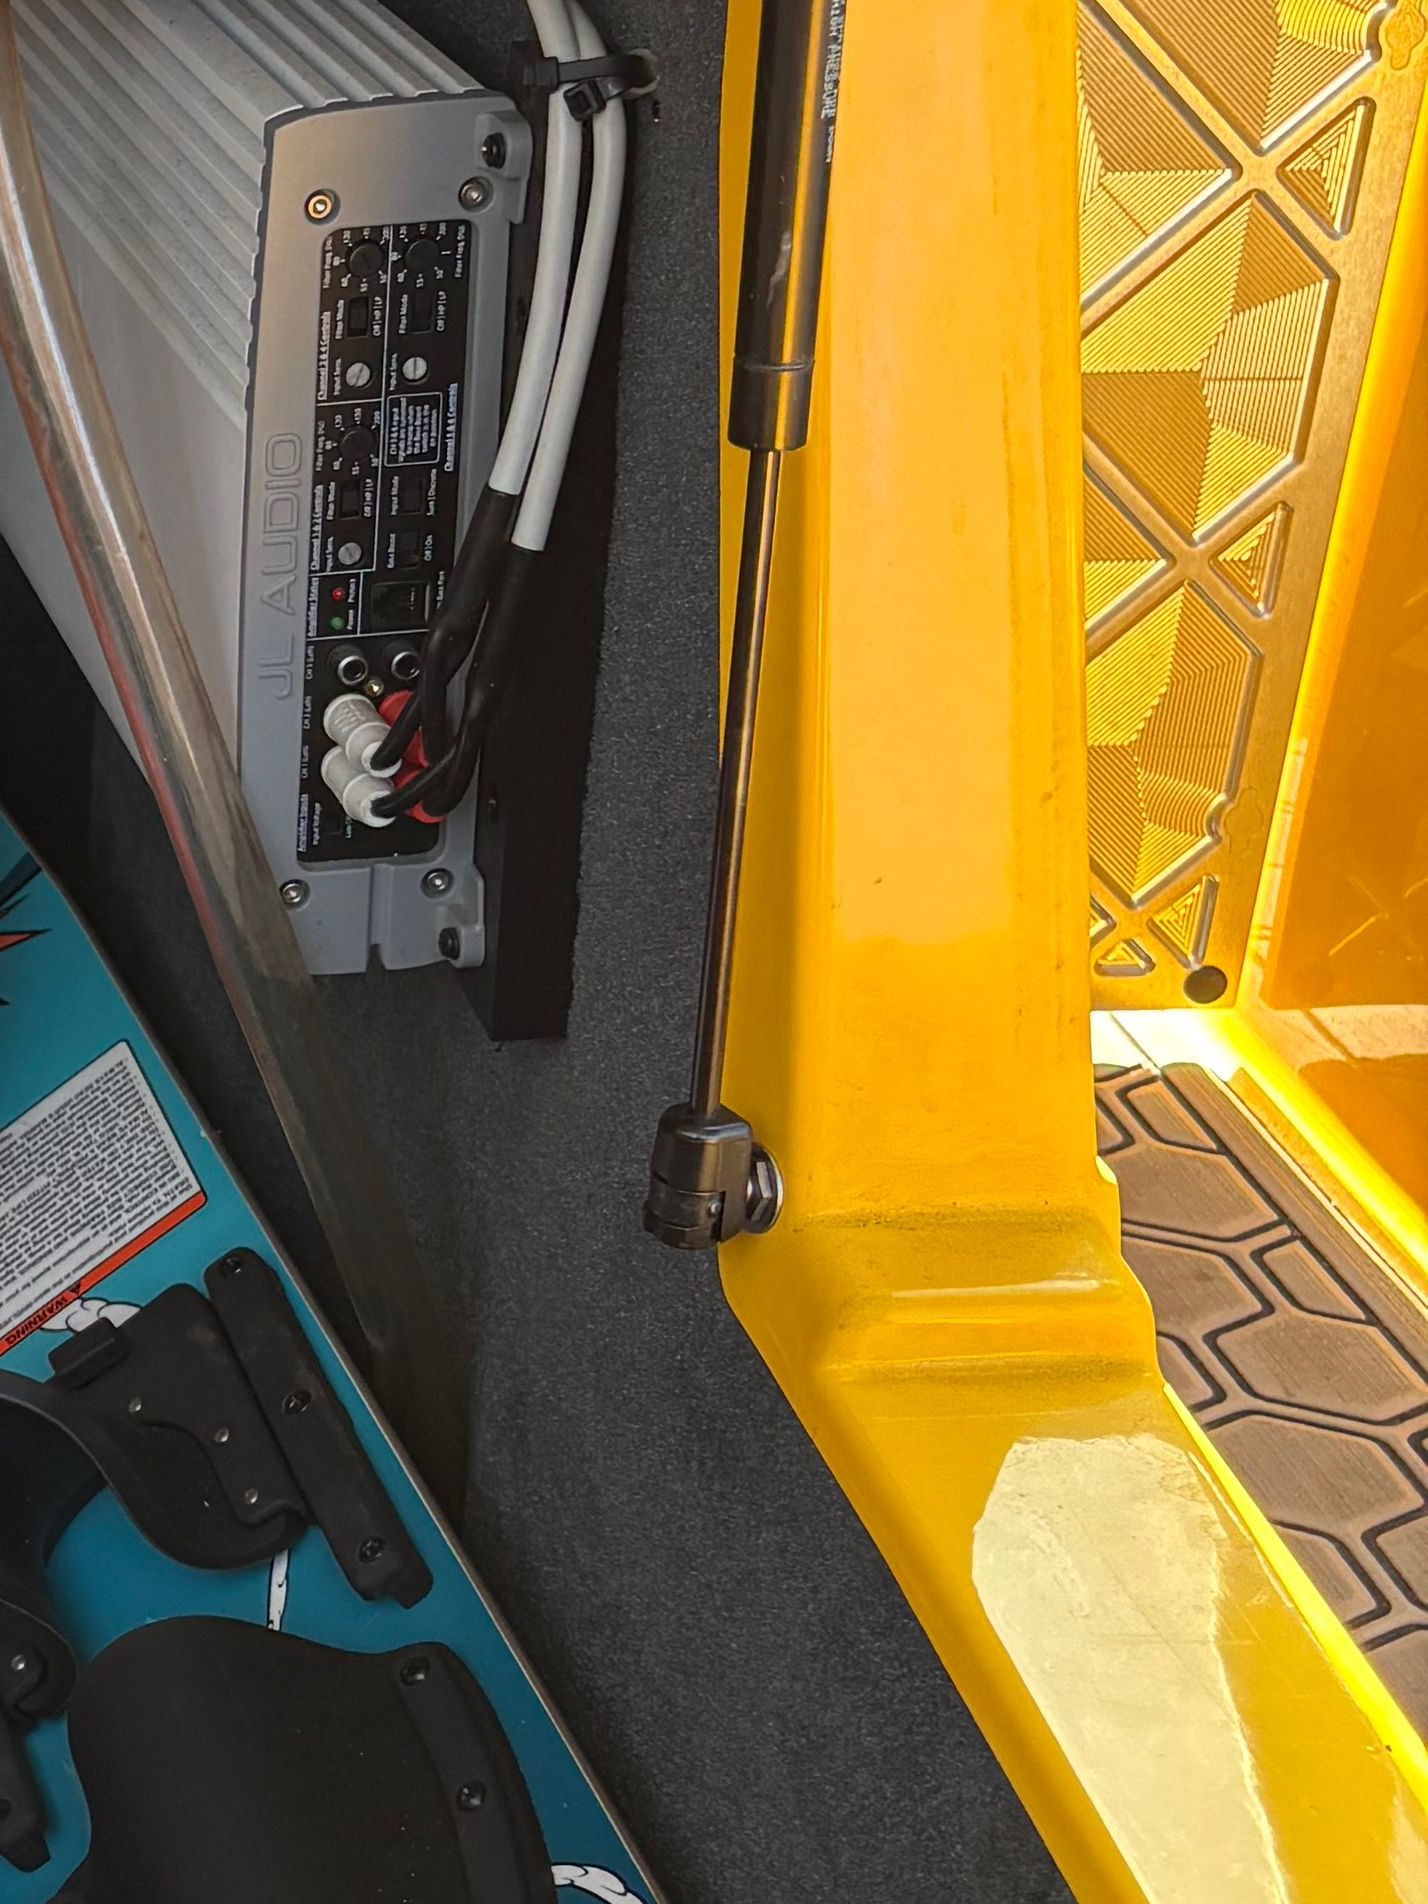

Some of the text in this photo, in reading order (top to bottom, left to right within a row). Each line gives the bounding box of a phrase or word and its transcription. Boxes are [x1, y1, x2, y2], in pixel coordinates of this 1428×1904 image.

[257, 432, 303, 700] JL AUDIO
[5, 1296, 68, 1348] WARNING
